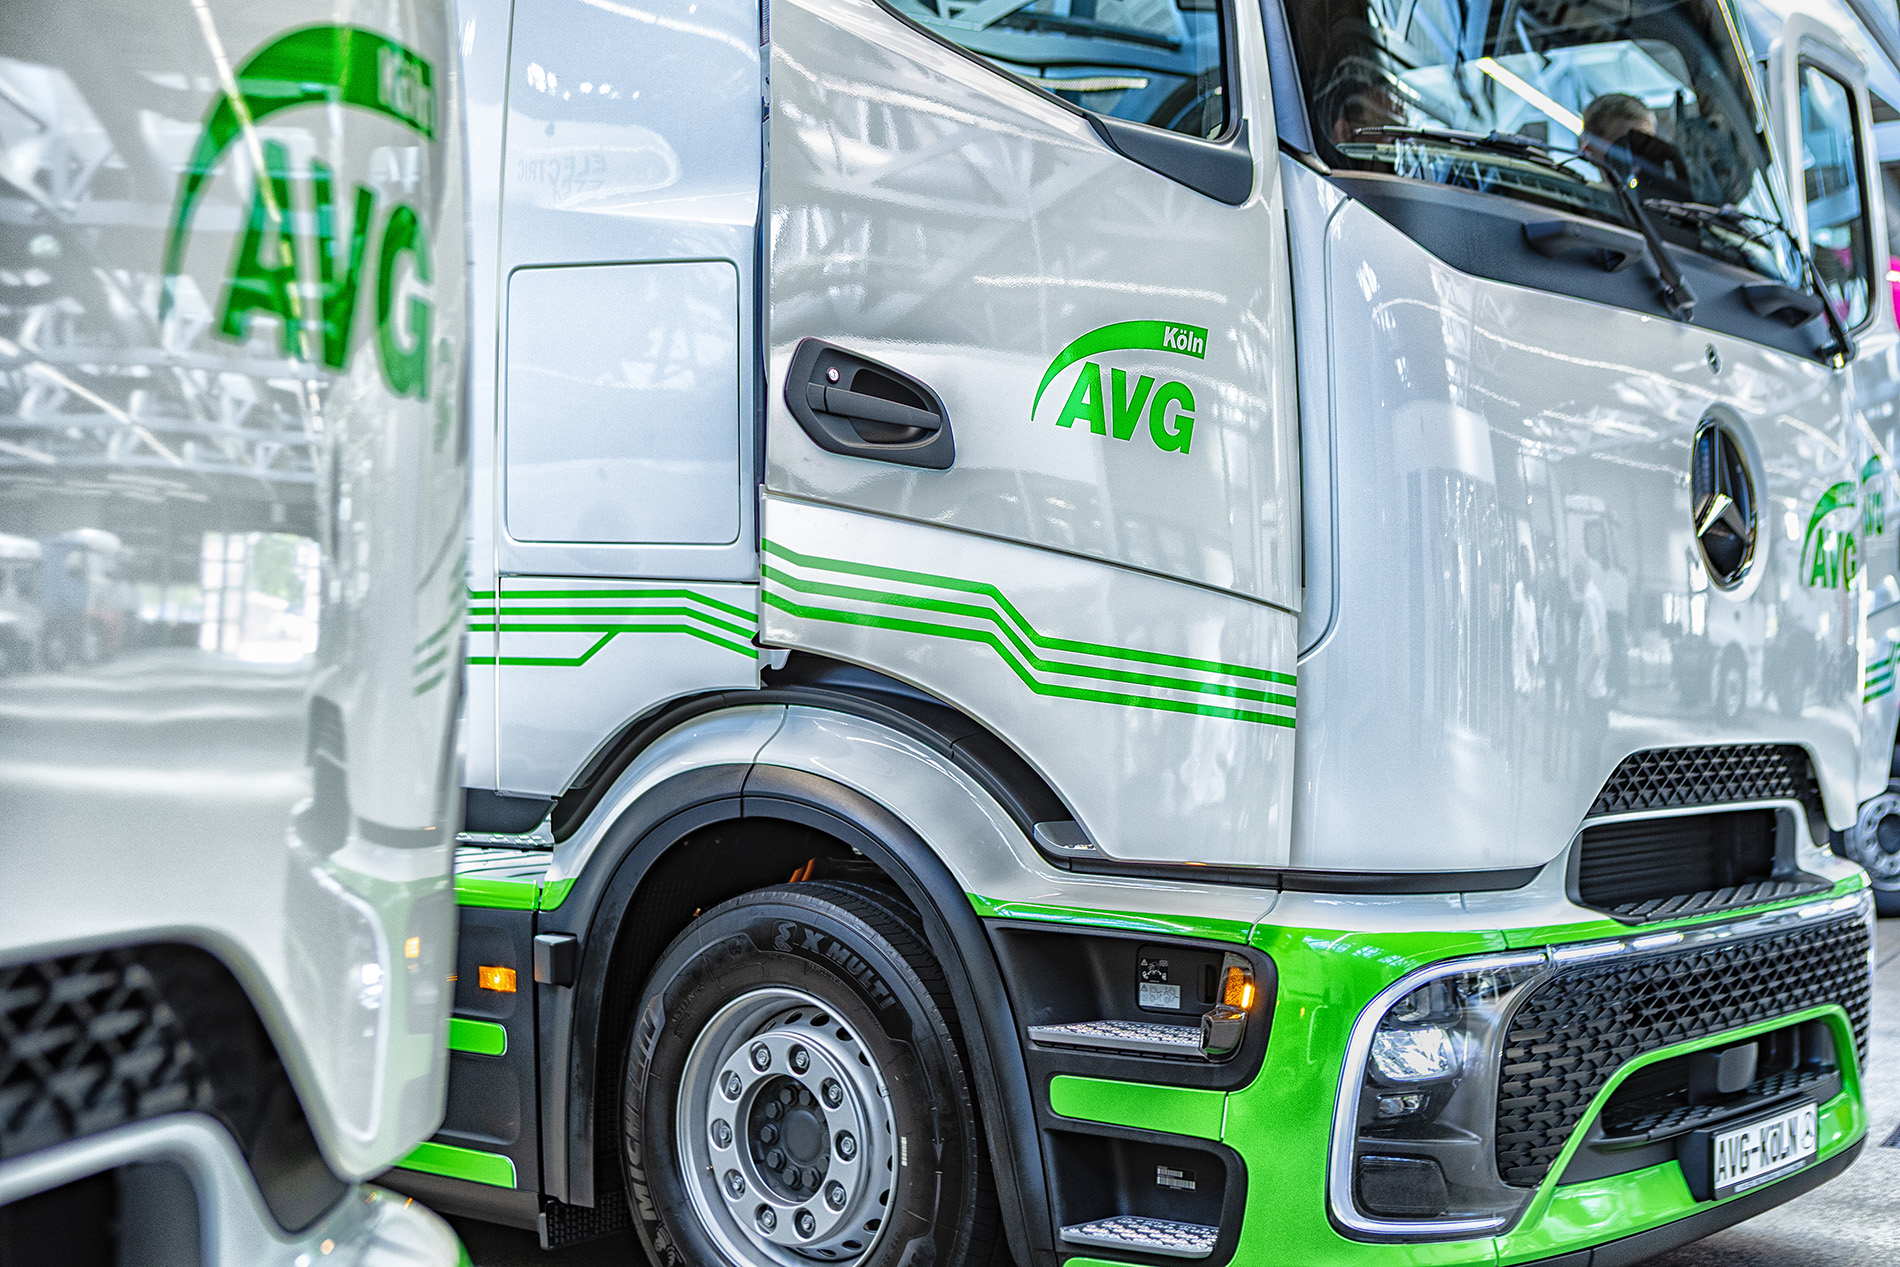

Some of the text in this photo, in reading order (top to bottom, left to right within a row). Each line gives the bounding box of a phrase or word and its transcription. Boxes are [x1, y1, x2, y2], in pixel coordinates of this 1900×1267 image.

[219, 139, 432, 399] AVG
[1162, 325, 1204, 354] Köln
[1055, 361, 1196, 455] AVG
[1809, 527, 1857, 592] AVG
[800, 927, 825, 954] X
[825, 943, 897, 1011] MULTI
[625, 1004, 659, 1221] MICHELIN
[1716, 1115, 1799, 1184] AVG-KÖLN
